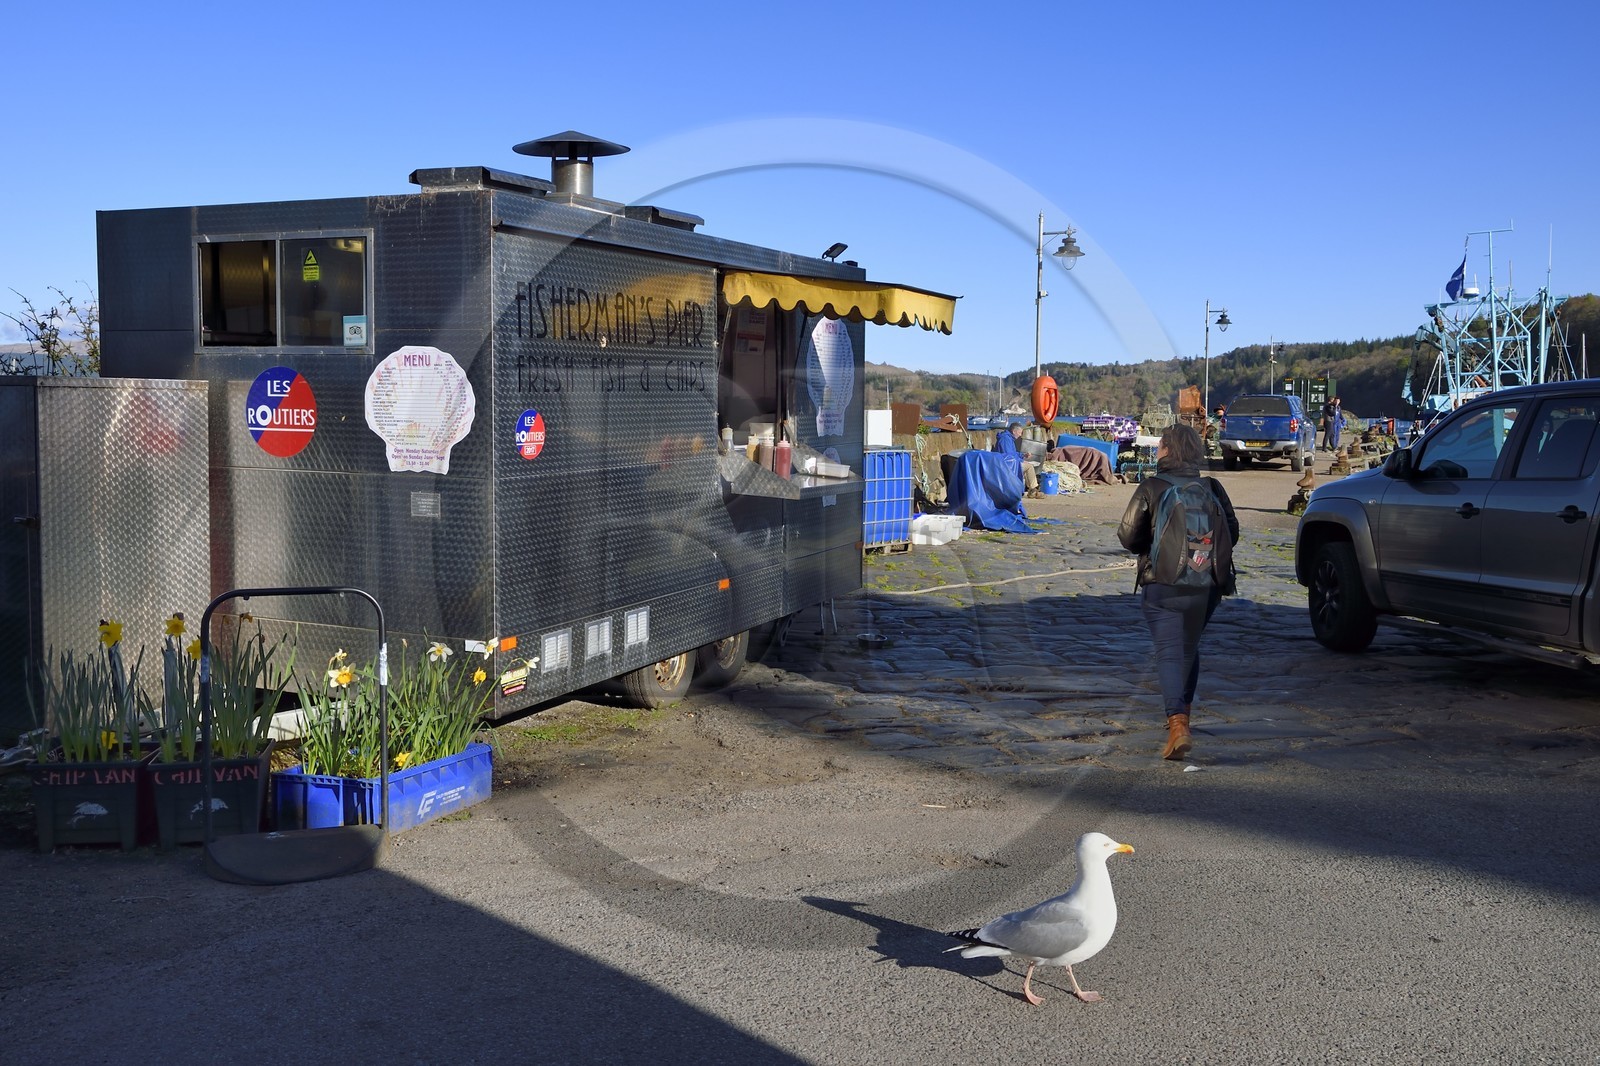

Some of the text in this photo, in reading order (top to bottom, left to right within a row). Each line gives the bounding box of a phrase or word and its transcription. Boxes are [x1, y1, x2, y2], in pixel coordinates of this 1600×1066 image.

[515, 281, 704, 348] FISHERMAN'S PIER
[403, 354, 431, 367] MENU
[516, 355, 575, 393] FRESH
[592, 357, 626, 392] FISH
[665, 359, 705, 392] CHIPS
[267, 380, 291, 397] LES
[248, 404, 315, 426] ROUTIERS
[525, 416, 535, 426] LES
[516, 430, 545, 442] ROUTIERS
[214, 765, 259, 782] VAN
